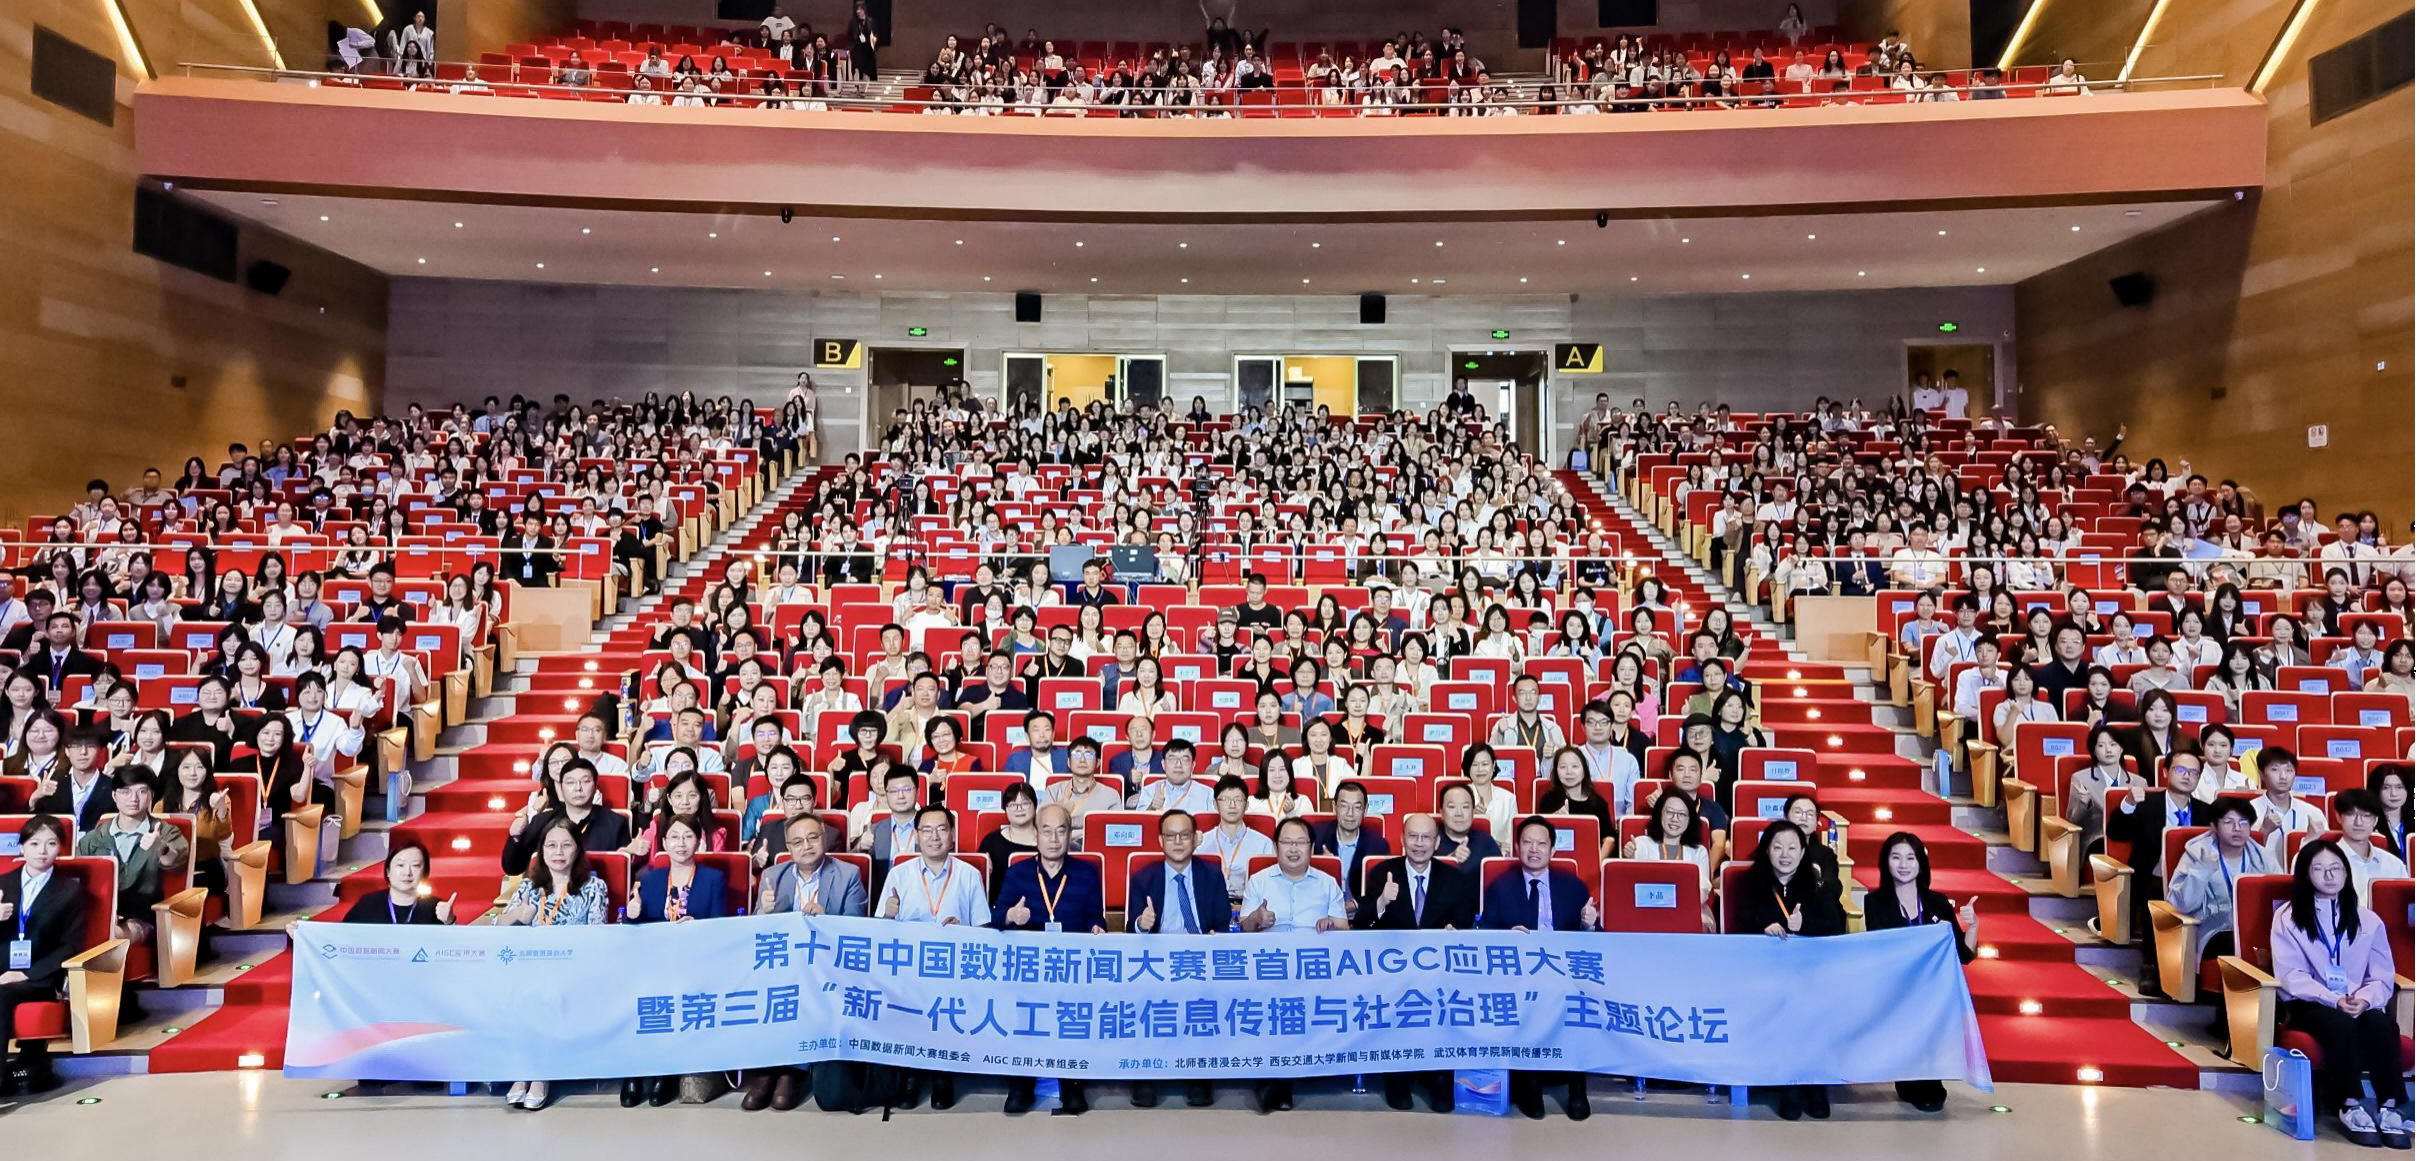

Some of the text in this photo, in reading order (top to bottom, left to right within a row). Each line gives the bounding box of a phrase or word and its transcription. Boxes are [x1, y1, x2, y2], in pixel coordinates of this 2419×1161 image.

[824, 341, 842, 363] B
[1565, 345, 1585, 367] A
[754, 930, 1606, 986] 第十届中国数据新闻大赛暨首届AIGC应用大赛
